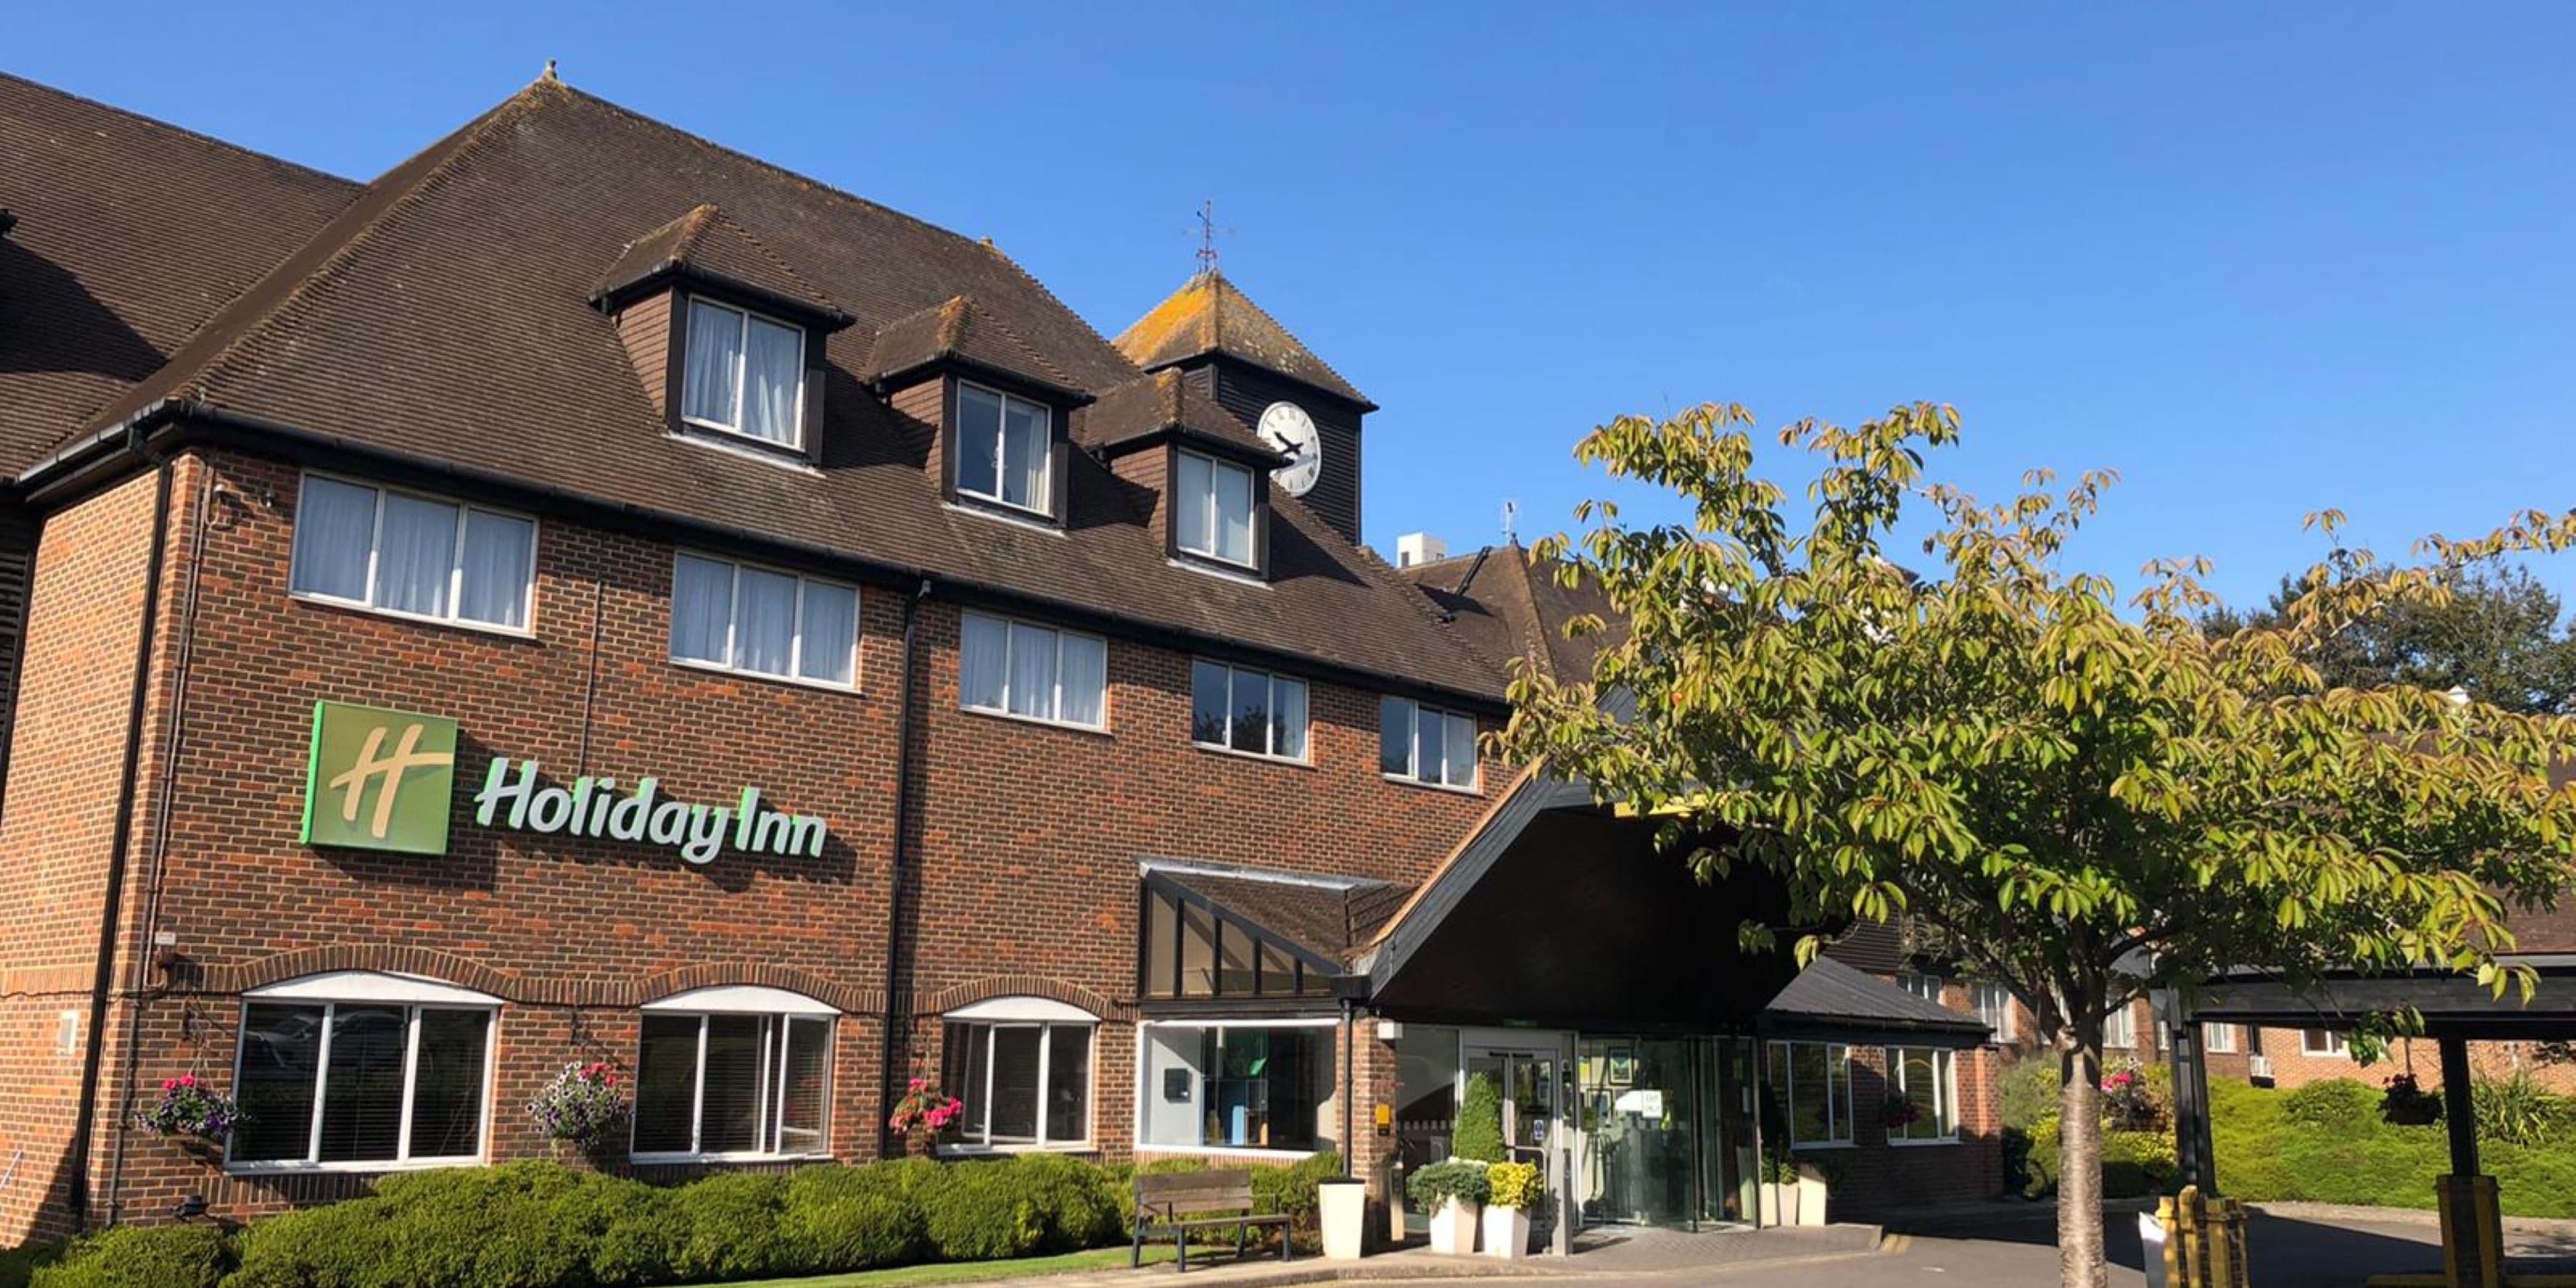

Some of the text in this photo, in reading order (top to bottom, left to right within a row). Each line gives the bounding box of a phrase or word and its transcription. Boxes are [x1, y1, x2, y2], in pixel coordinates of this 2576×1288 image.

[329, 723, 454, 839] H
[474, 757, 827, 864] Holiday Inn
